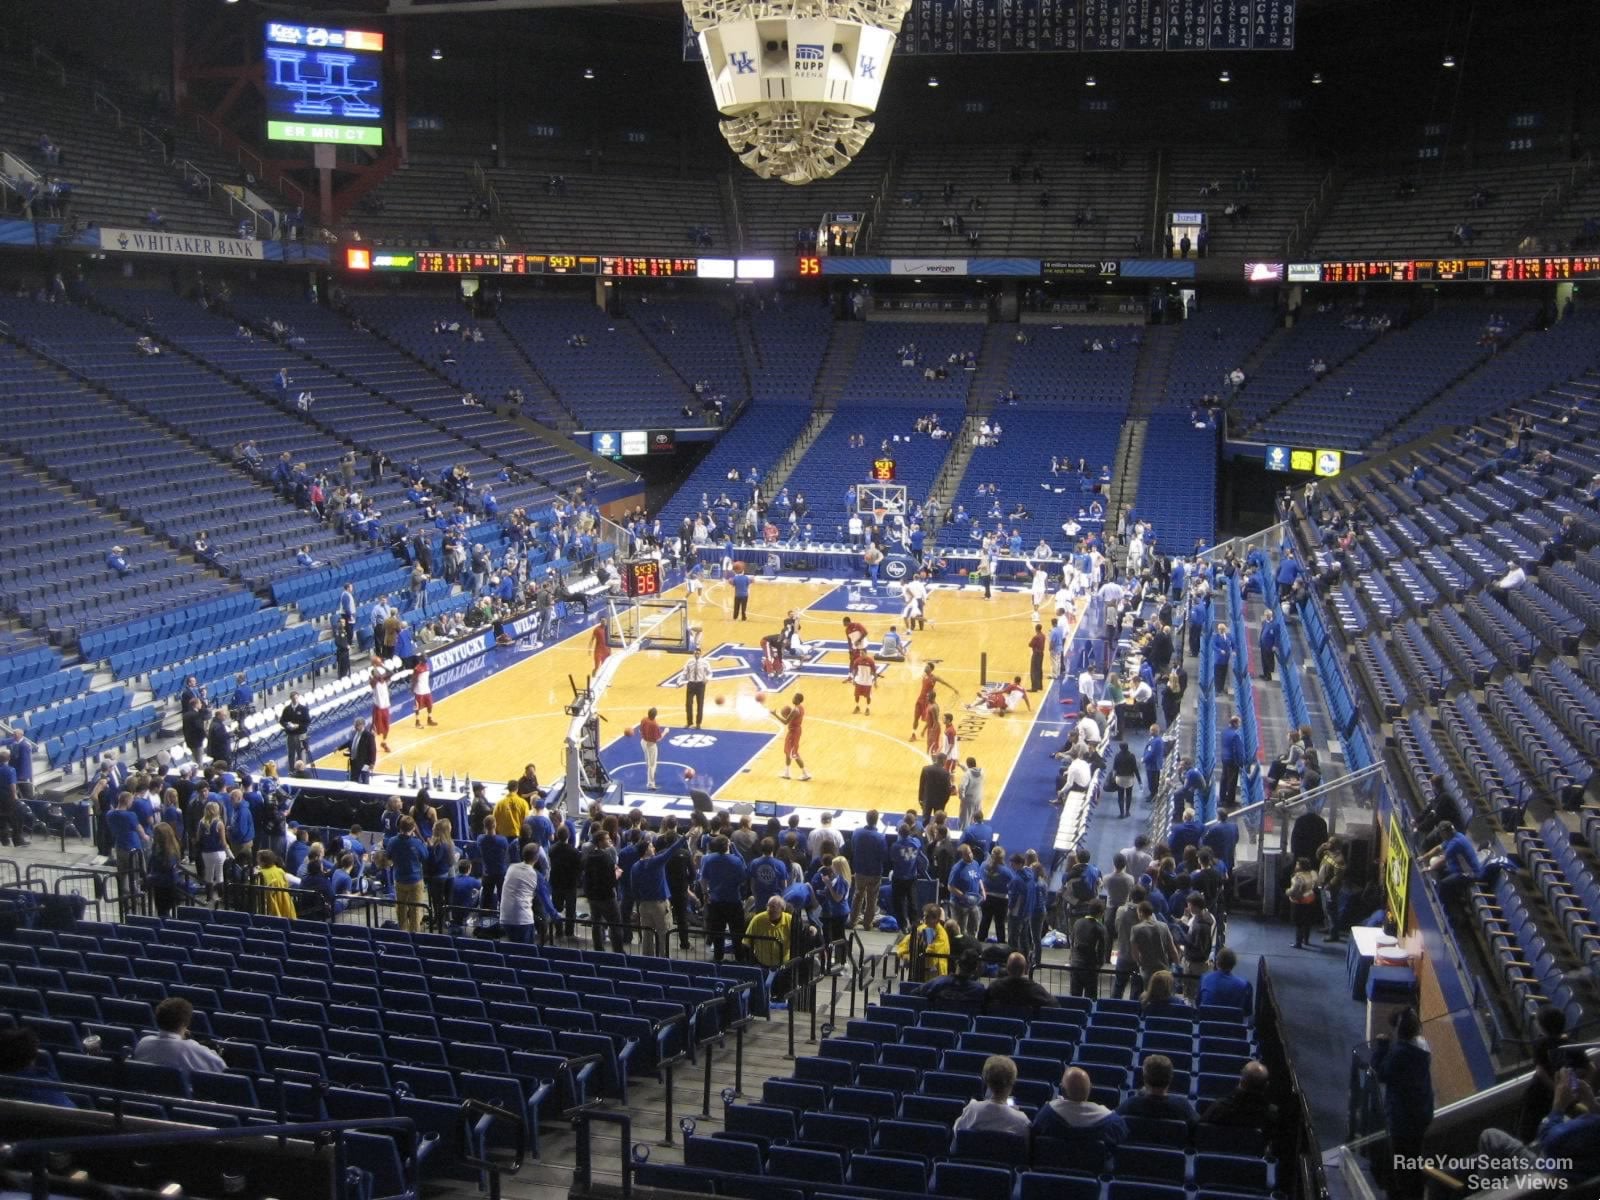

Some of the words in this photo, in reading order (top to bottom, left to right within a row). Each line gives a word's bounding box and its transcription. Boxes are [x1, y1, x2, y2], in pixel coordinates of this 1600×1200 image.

[946, 11, 954, 50] 1975
[988, 8, 996, 49] 1978
[1028, 8, 1036, 50] 1984
[1066, 8, 1076, 49] 1993
[1111, 7, 1120, 48] 1996
[1152, 6, 1162, 47] 1997
[1196, 6, 1206, 47] 1998
[1213, 0, 1222, 36] CAA
[1240, 6, 1249, 48] 2011
[1256, 0, 1266, 36] CAA
[1270, 0, 1279, 44] HAMPION
[1283, 5, 1293, 47] 2012
[728, 51, 757, 75] UK
[794, 62, 824, 70] RUPP
[860, 54, 877, 80] UK
[284, 126, 306, 137] ER
[311, 127, 339, 139] MRI
[345, 128, 365, 140] CT
[133, 234, 214, 254] WHITAKER
[218, 240, 254, 257] BANK
[800, 258, 819, 274] 35
[926, 264, 954, 273] verizon
[1100, 262, 1116, 273] yp
[1438, 260, 1464, 272] 54:37
[634, 562, 657, 576] 54:37
[638, 574, 655, 594] 35
[430, 634, 486, 672] KENTUCKY
[668, 734, 718, 748] SEC
